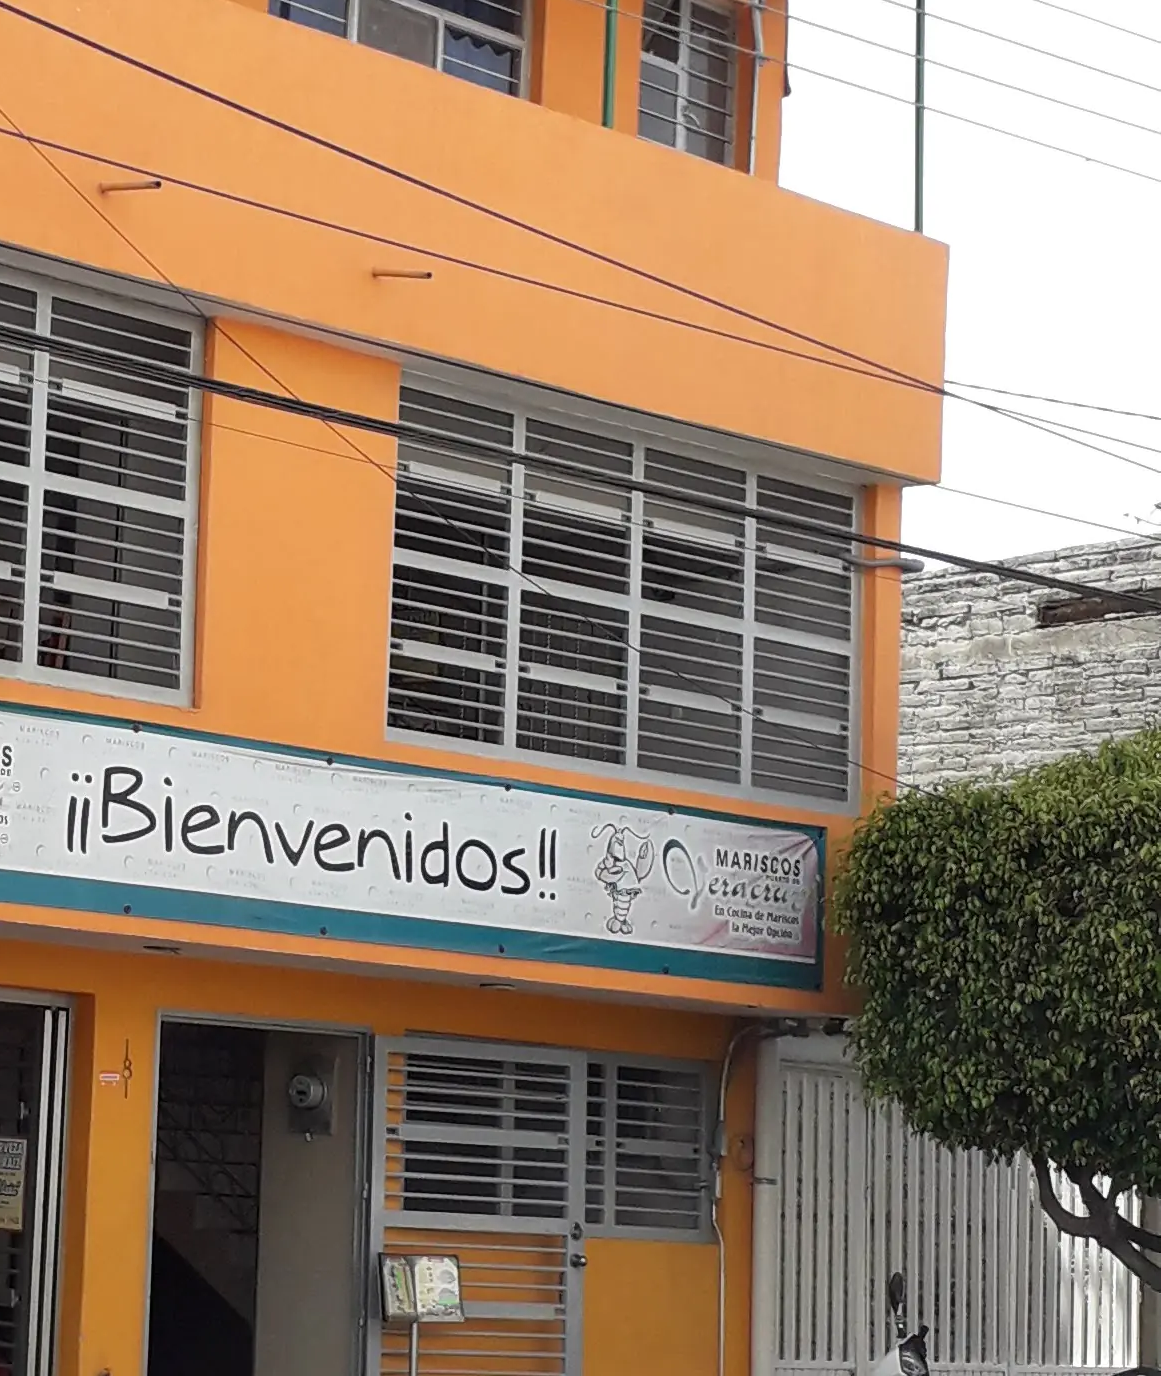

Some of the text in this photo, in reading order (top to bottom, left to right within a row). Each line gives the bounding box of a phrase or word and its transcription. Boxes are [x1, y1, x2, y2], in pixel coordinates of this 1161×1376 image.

[0, 767, 12, 777] DE
[65, 764, 559, 902] ¡¡Bienvenidos!!
[714, 848, 801, 878] MARISCOS
[714, 904, 800, 925] En Cocina de Mariscos
[741, 922, 764, 937] Mejor
